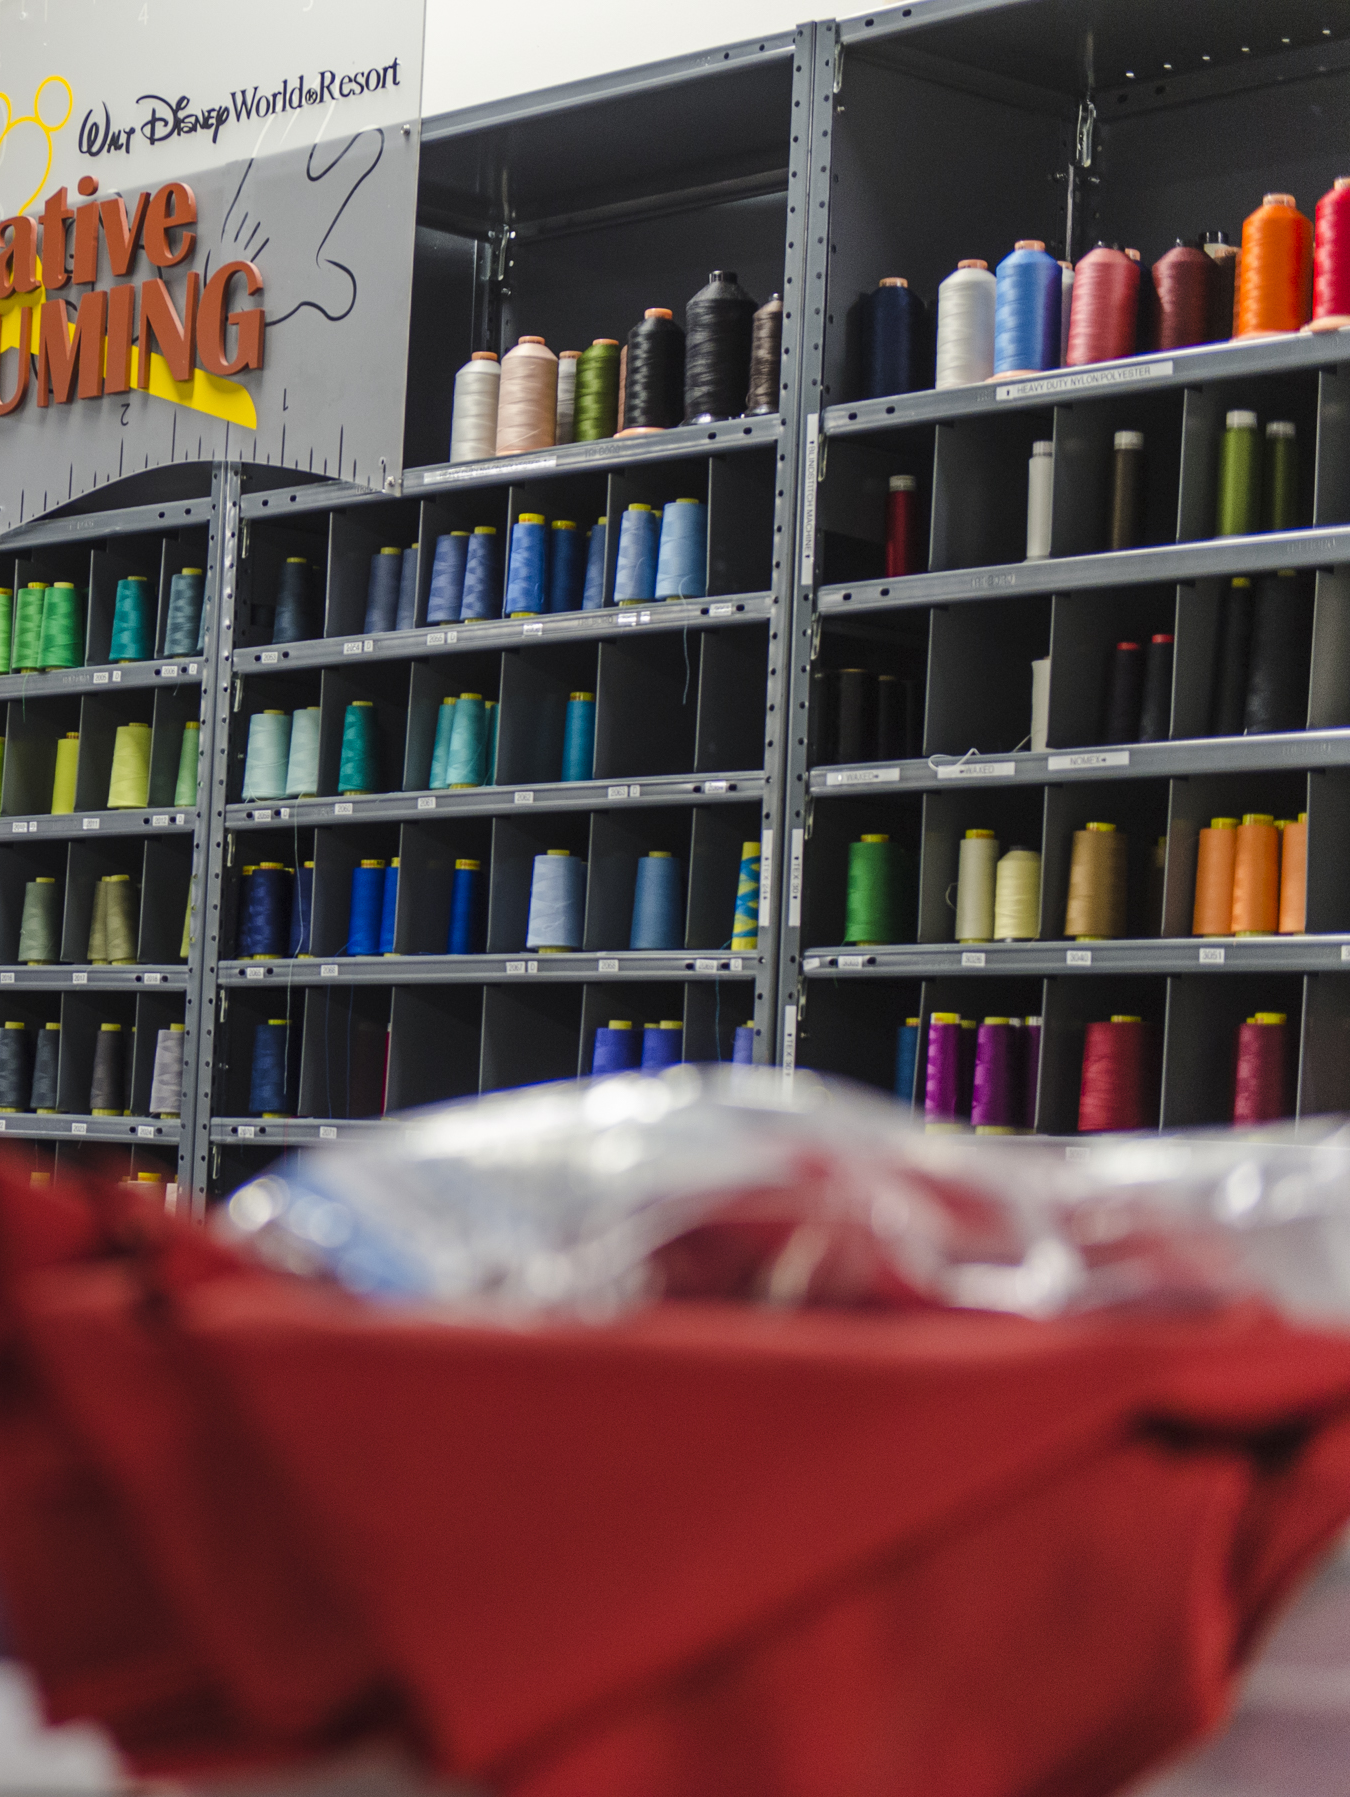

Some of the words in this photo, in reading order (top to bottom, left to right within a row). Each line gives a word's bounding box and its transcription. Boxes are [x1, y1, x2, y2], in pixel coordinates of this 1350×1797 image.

[317, 57, 401, 104] Resort
[1016, 381, 1043, 394] HEAVY
[1046, 378, 1068, 390] DUTY
[806, 446, 816, 508] BLINDSTITCH
[804, 509, 814, 552] MACHINE
[1070, 756, 1100, 766] NOMEX
[846, 772, 874, 782] WAXED
[965, 765, 994, 775] WAXED
[792, 862, 800, 879] TEX
[792, 882, 800, 894] 30
[1202, 950, 1222, 960] 3051
